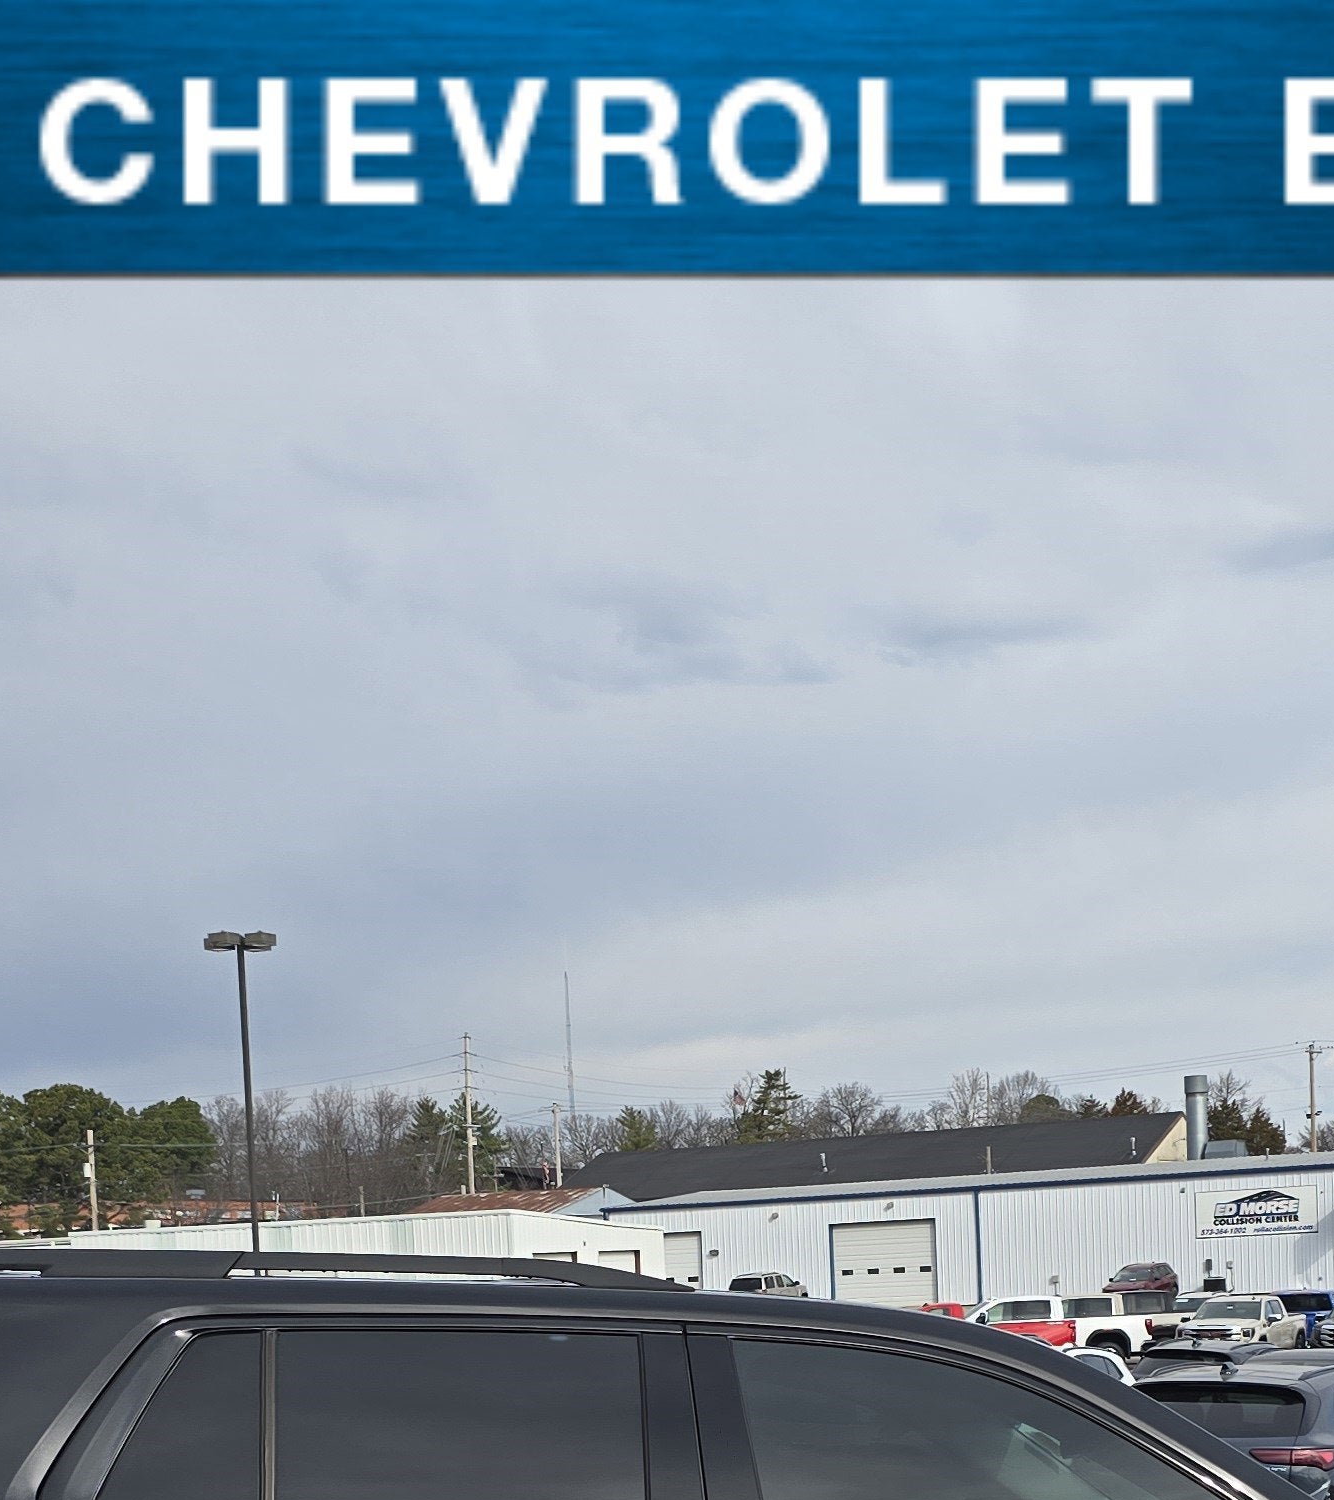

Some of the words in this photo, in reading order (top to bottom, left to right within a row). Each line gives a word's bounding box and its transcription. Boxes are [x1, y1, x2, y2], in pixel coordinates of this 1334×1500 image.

[1215, 1203, 1237, 1216] ED
[1238, 1199, 1299, 1215] MORSE
[1213, 1216, 1263, 1226] COLLISION
[1264, 1214, 1299, 1223] CENTER
[1201, 1226, 1247, 1236] 573-364-1002
